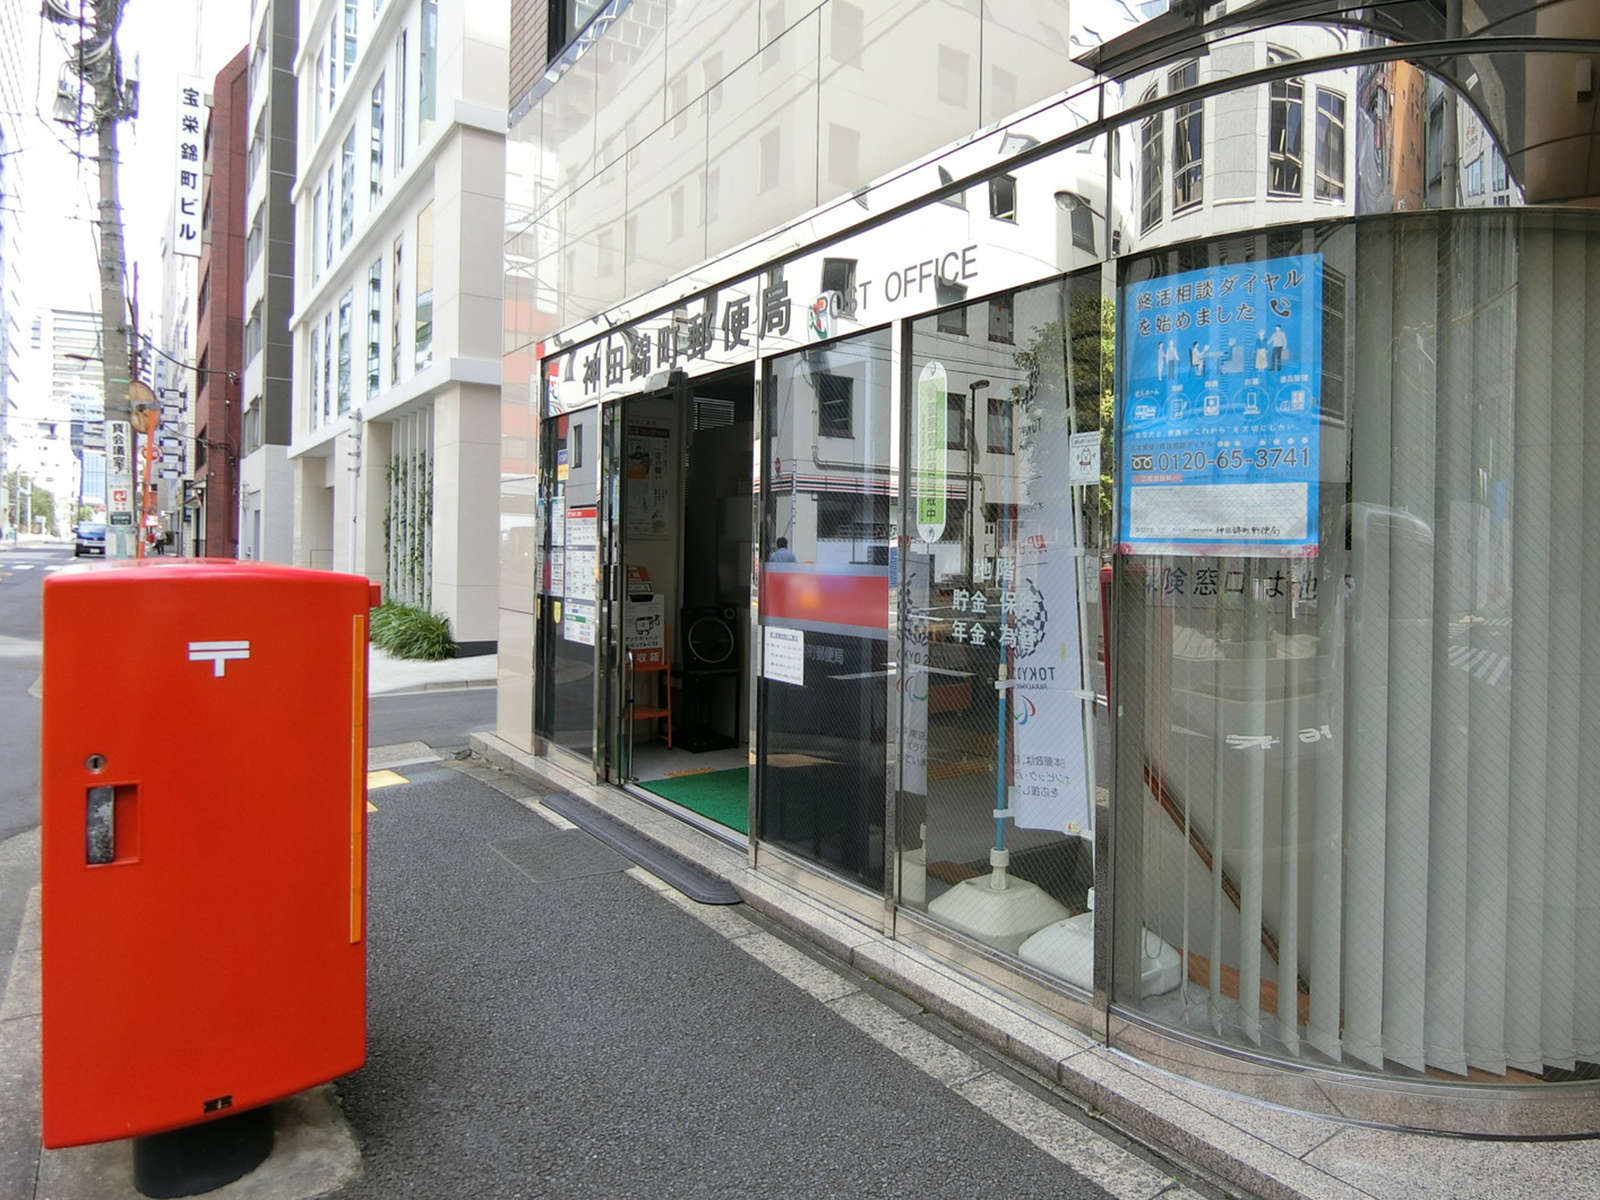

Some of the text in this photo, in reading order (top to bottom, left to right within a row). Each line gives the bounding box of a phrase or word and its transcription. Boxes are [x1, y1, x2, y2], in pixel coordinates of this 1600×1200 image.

[178, 87, 200, 241] 宝栄錦町ビル
[1136, 270, 1305, 312] 終活相談ダイヤル
[582, 280, 791, 396] 神田錦町郵便局
[885, 244, 979, 302] OFFICE
[1138, 303, 1255, 336] を始めました
[1158, 446, 1309, 472] 0120-65-3741
[974, 558, 1015, 583] 地階
